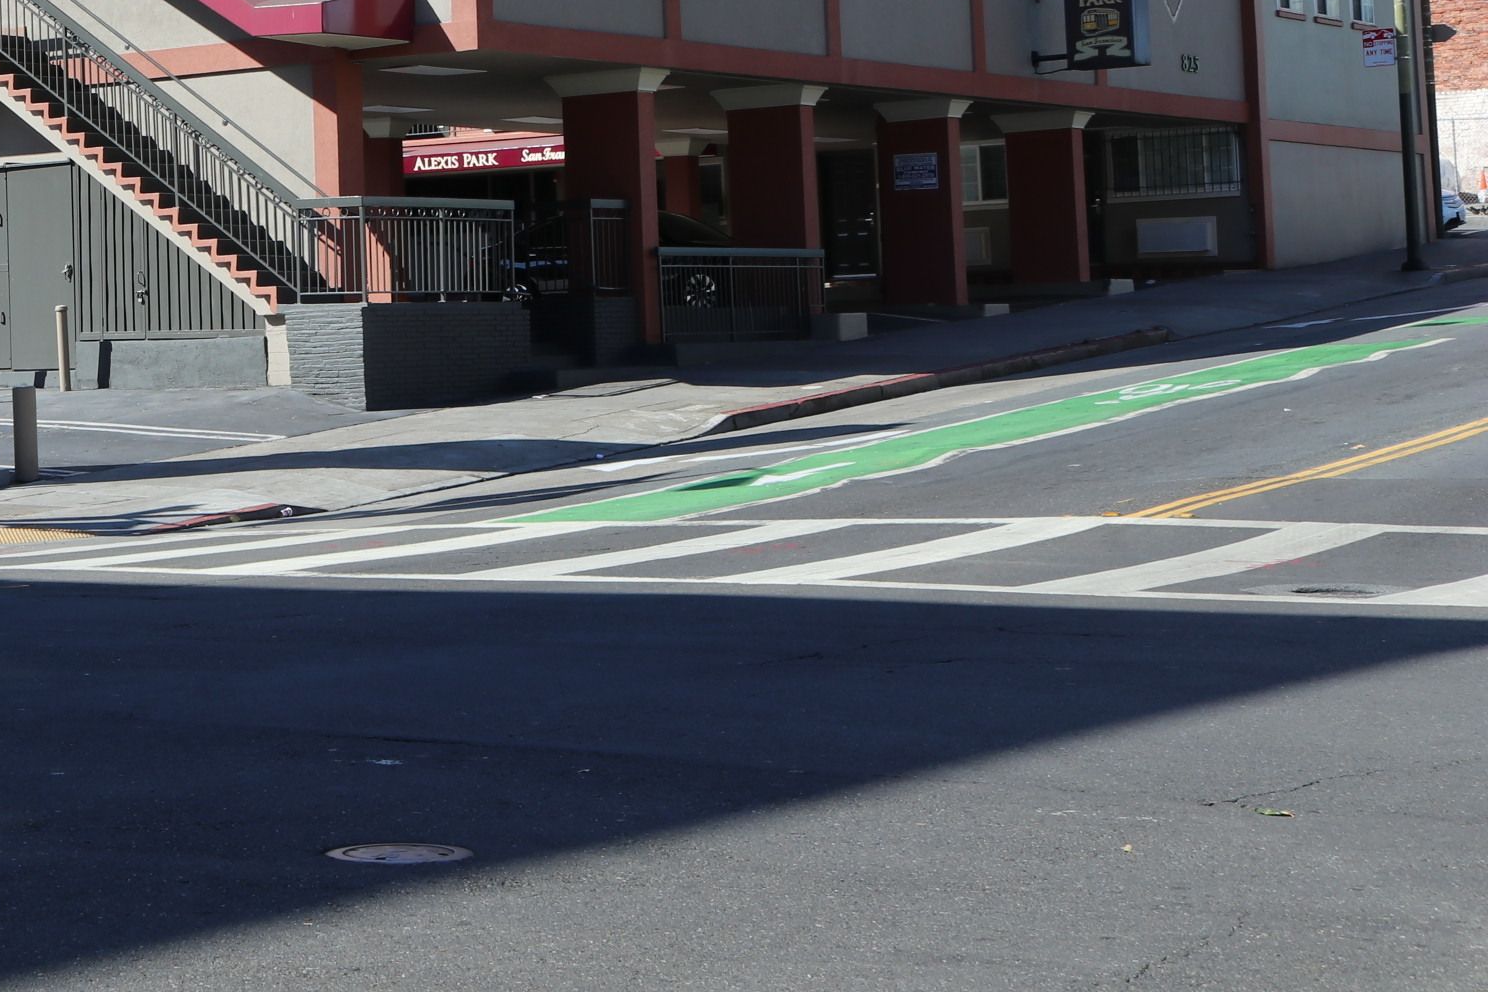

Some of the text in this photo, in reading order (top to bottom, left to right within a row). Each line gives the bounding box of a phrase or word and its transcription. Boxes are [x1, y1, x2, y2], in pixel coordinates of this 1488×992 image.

[1181, 54, 1200, 73] 825
[413, 157, 459, 171] ALEXIS
[463, 153, 499, 168] PARK
[521, 149, 542, 163] San
